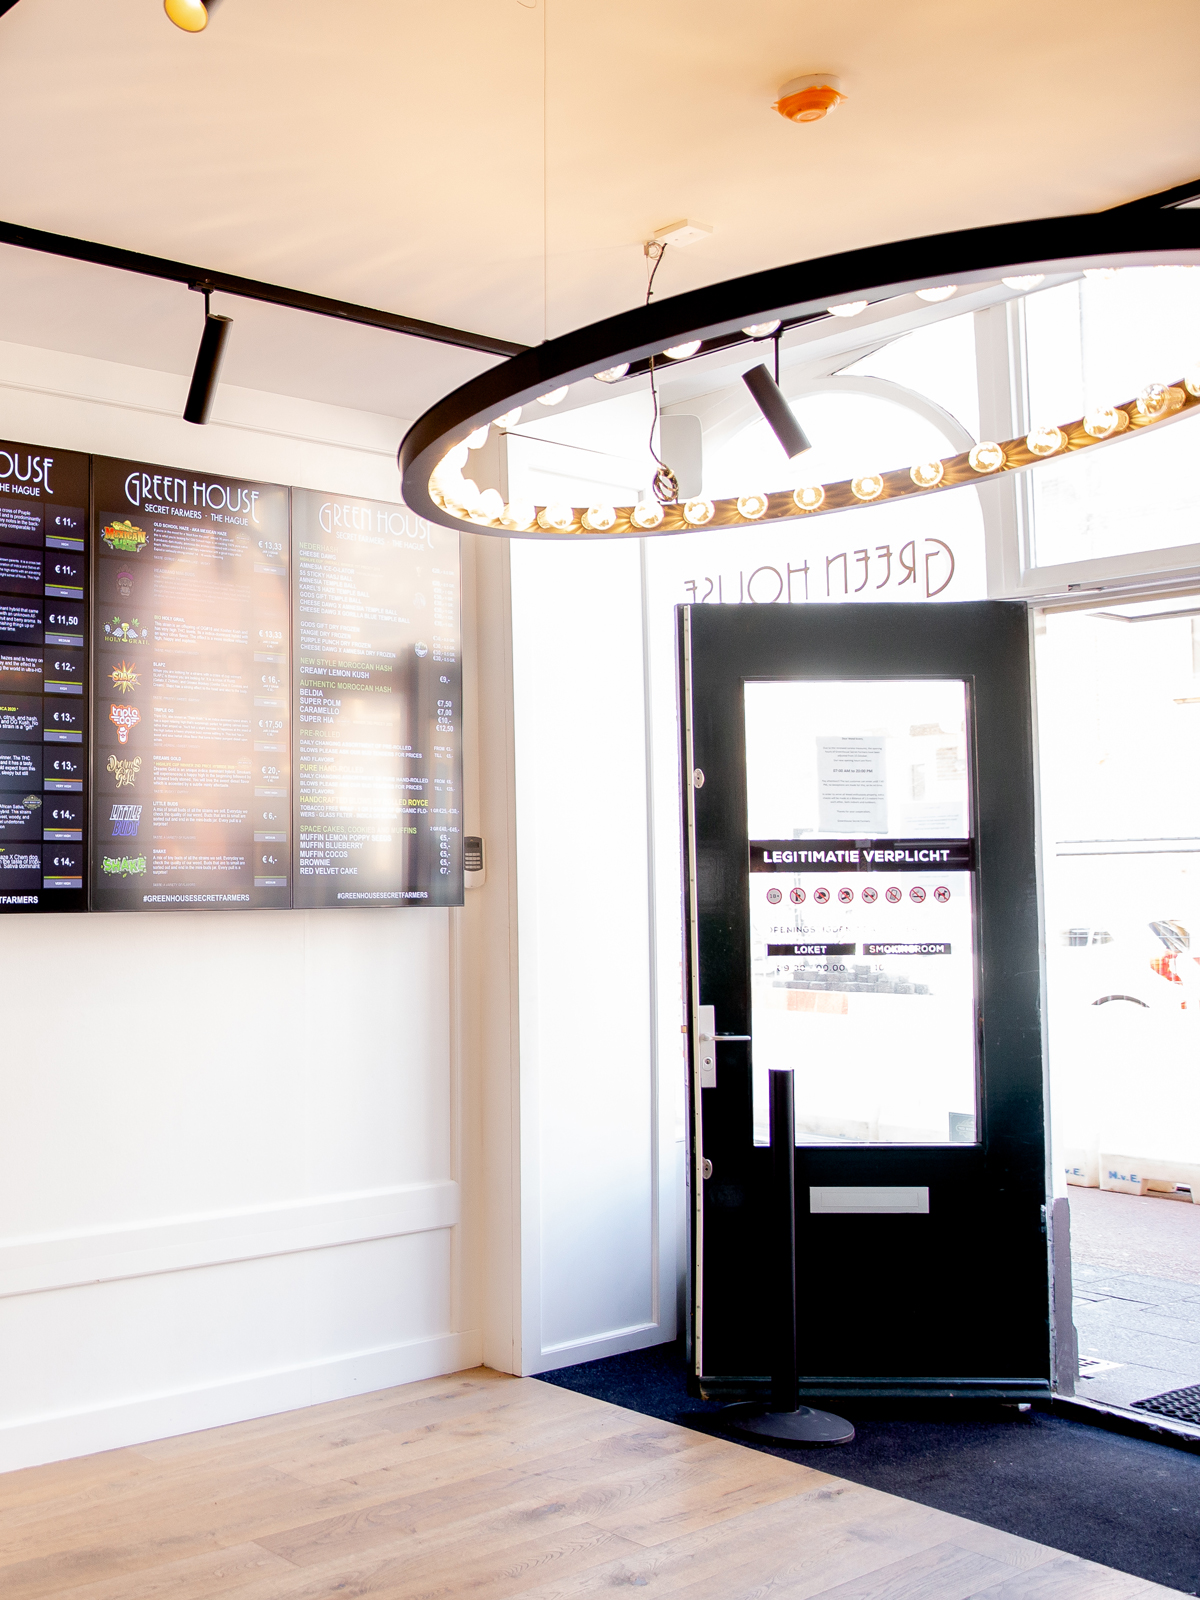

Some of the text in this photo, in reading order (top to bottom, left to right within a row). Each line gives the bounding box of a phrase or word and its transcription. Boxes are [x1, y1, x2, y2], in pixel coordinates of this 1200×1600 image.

[12, 485, 40, 496] HAGUE
[125, 472, 259, 523] GREEN HOUSE
[145, 504, 248, 526] SECRET FARMERS THE HAGUE
[319, 503, 434, 549] GREEN HOUSE
[104, 526, 146, 543] MEXICAN
[336, 531, 424, 550] SECRET FARMERS THE HAGUE
[299, 542, 338, 553] NEDERHASH
[300, 550, 319, 558] CHEESE
[301, 657, 392, 672] NEW STYLE MOROCCAN HASH
[113, 671, 137, 682] SLAPZ
[300, 667, 369, 679] CREAMY LEMON KUSH
[300, 680, 391, 693] AUTHENTIC MOROCCAN HASH
[300, 697, 322, 705] SUPER
[300, 706, 339, 714] CARAMELLO
[110, 805, 142, 820] LITTLE
[112, 820, 139, 836] BUDS
[763, 850, 950, 863] LEGITIMATIE VERPLICHT
[103, 856, 146, 874] SHAKE
[143, 894, 249, 902] #GREENHOUSESECRETFARMERS
[338, 891, 427, 899] #GREENHOUSESECRETFARMERS
[794, 945, 827, 954] LOKET
[1109, 1171, 1140, 1183] N.v.E.
